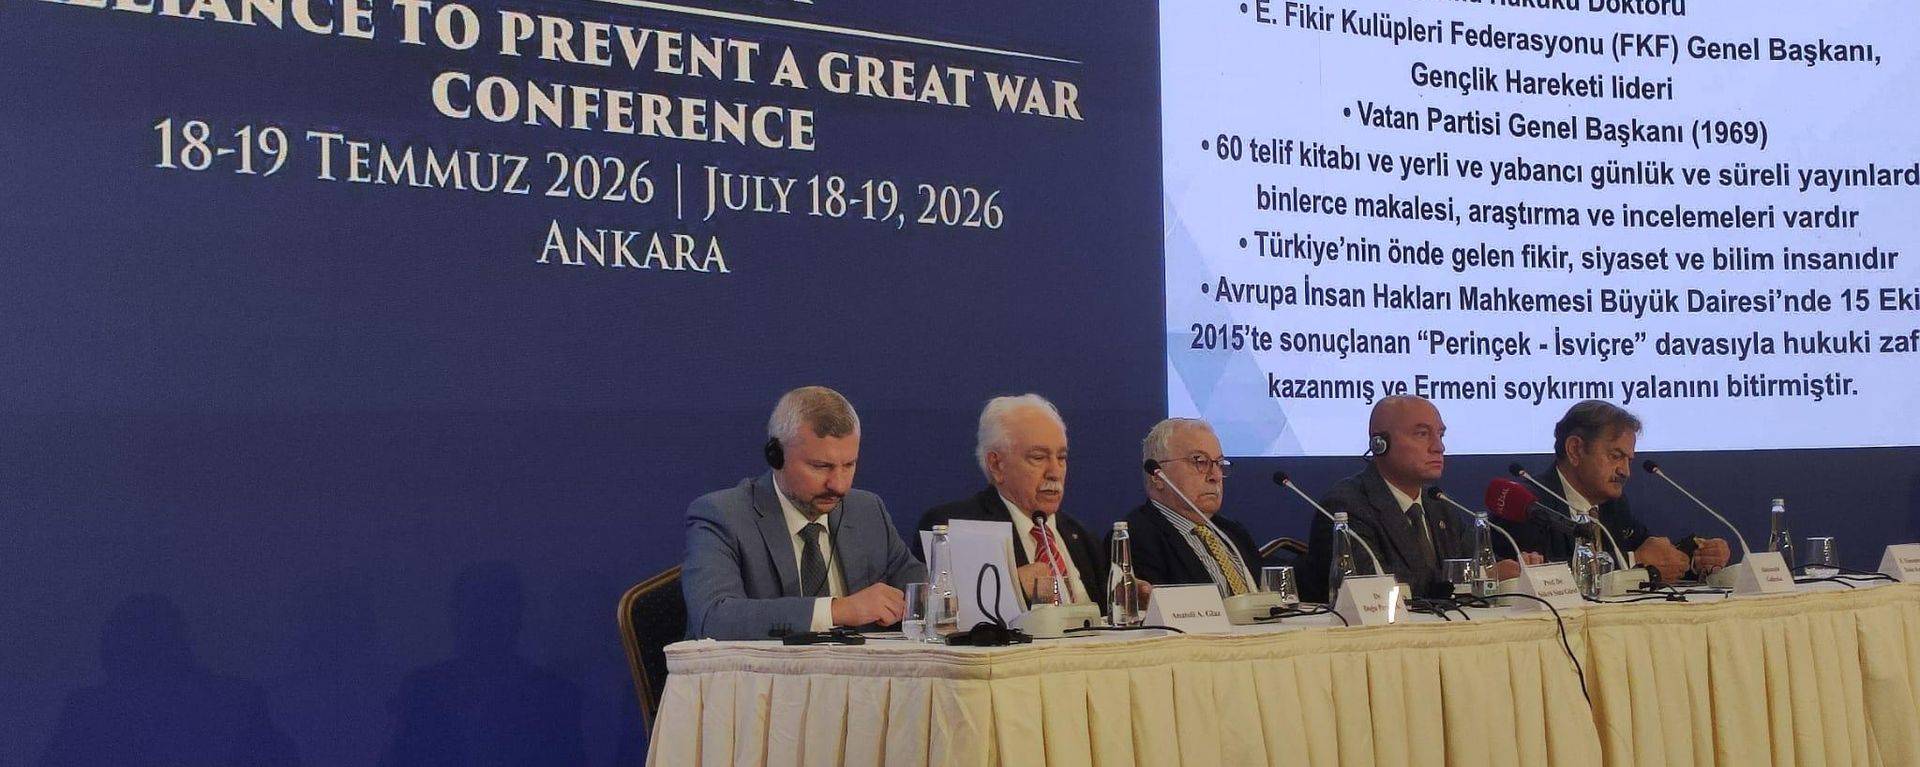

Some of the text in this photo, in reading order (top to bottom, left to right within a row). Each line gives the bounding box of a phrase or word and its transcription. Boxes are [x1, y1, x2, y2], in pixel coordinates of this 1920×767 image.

[1256, 0, 1880, 67] E. Fikir Kulüpleri Federasyonu (FKF) Genel Başkanı,
[392, 0, 480, 50] TO
[498, 10, 760, 83] PREVENT
[770, 46, 808, 89] A
[818, 52, 974, 107] GREAT
[983, 72, 1084, 120] WAR
[1411, 62, 1672, 100] Gençlik Hareketi lideri
[432, 72, 815, 151] CONFERENCE
[1357, 100, 1767, 150] Vatan Partisi Genel Başkanı (1969)
[154, 118, 288, 177] 18-19
[306, 131, 530, 194] TEMMUZ
[545, 152, 654, 203] 2026
[703, 166, 797, 221] JULY
[807, 175, 904, 229] 18-19,
[917, 184, 1003, 229] 2026
[1217, 134, 1242, 161] 60
[1250, 138, 1293, 165] telif
[1300, 141, 1360, 170] kitabı
[1367, 153, 1393, 173] ve
[1399, 152, 1448, 181] yerli
[1456, 159, 1483, 178] ve
[1490, 157, 1582, 186] yabancı
[1591, 160, 1674, 190] günlük
[1682, 168, 1710, 185] ve
[1719, 163, 1789, 186] süreli
[1257, 184, 1859, 230] binlerce makalesi, araştırma ve incelemeleri vardır
[536, 219, 731, 273] ANKARA
[1254, 231, 1899, 276] Türkiye’nin önde gelen fikir, siyaset ve bilim insanıdır
[1215, 276, 1297, 310] Avrupa
[1305, 274, 1365, 307] İnsan
[1373, 283, 1451, 310] Hakları
[1459, 286, 1592, 312] Mahkemesi
[1601, 289, 1679, 319] Büyük
[1688, 289, 1831, 313] Dairesi’nde
[1841, 288, 1870, 311] 15
[1191, 323, 1272, 351] 2015’te
[1280, 328, 1410, 359] sonuçlanan
[1418, 330, 1531, 361] “Perinçek
[1555, 326, 1646, 362] İsviçre”
[1656, 331, 1775, 361] davasıyla
[1784, 330, 1870, 354] hukuki
[1268, 372, 1858, 406] kazanmış ve Ermeni soykırımı yalanını bitirmiştir.
